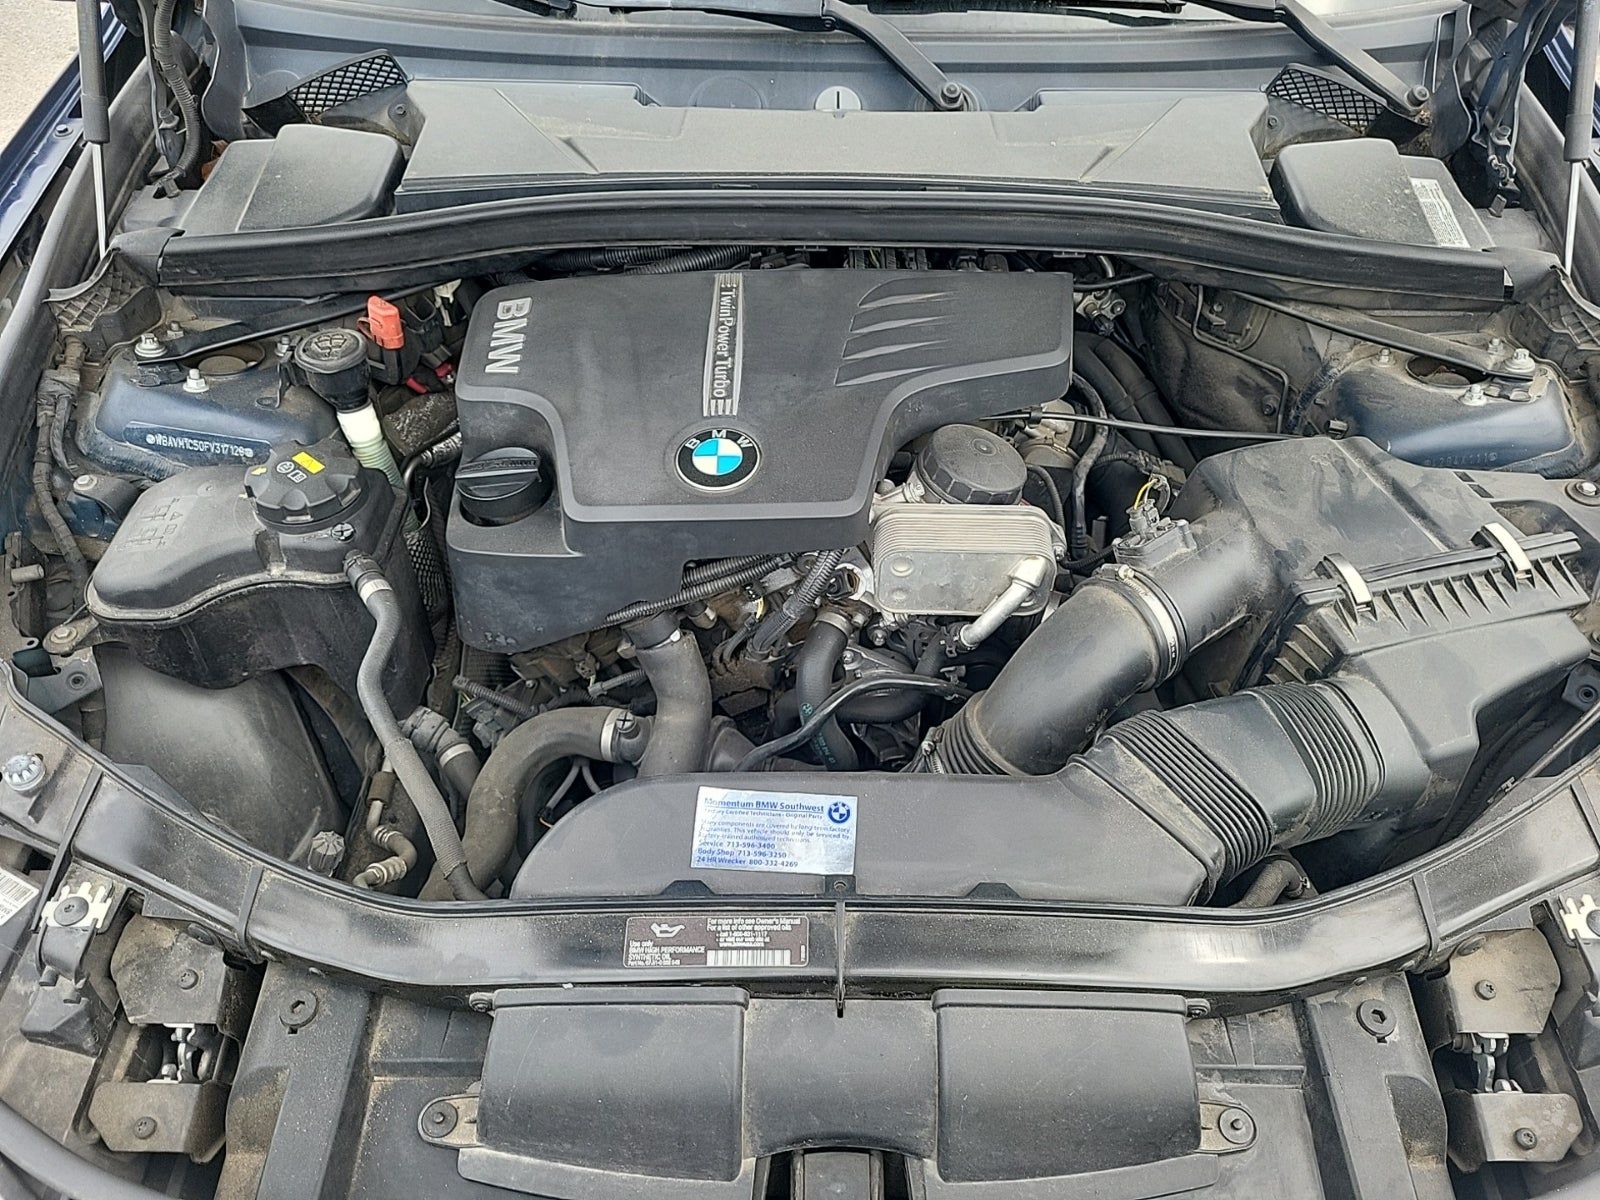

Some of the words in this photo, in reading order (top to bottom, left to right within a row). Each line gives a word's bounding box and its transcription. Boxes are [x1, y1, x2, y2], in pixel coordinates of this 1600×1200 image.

[485, 297, 531, 373] BMW
[716, 288, 737, 360] TwinPower
[712, 357, 733, 398] Turbo
[685, 429, 753, 450] BMW
[704, 798, 754, 808] Momentum
[755, 800, 778, 809] BMW
[780, 802, 824, 812] Southwest
[697, 848, 716, 856] Body
[738, 850, 787, 858] 713-596-3250
